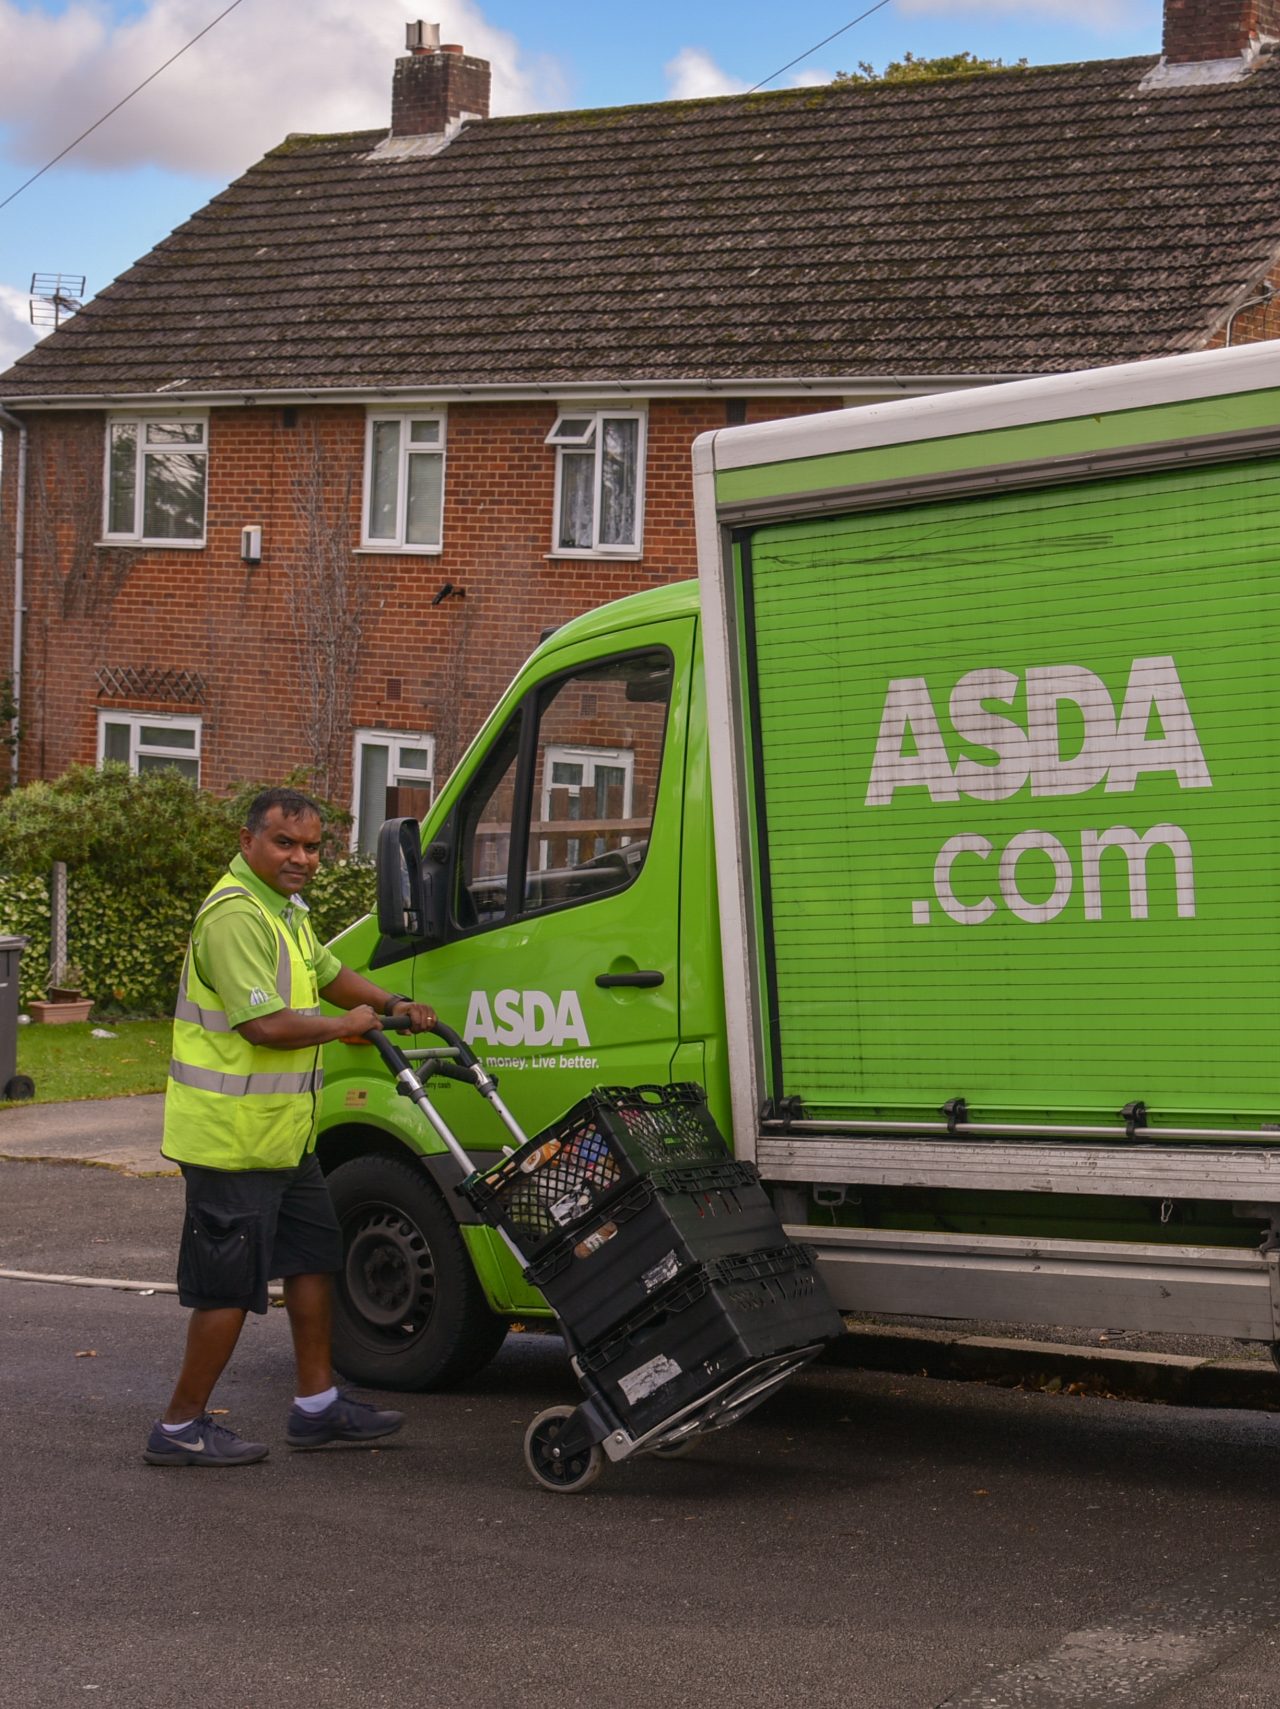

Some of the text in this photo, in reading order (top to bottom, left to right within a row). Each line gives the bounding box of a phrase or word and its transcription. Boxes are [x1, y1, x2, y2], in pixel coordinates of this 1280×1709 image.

[864, 654, 1213, 806] ASDA
[911, 822, 1196, 925] .com
[463, 988, 592, 1047] ASDA
[486, 1057, 529, 1071] money.
[532, 1056, 556, 1069] Live
[559, 1055, 600, 1069] better.
